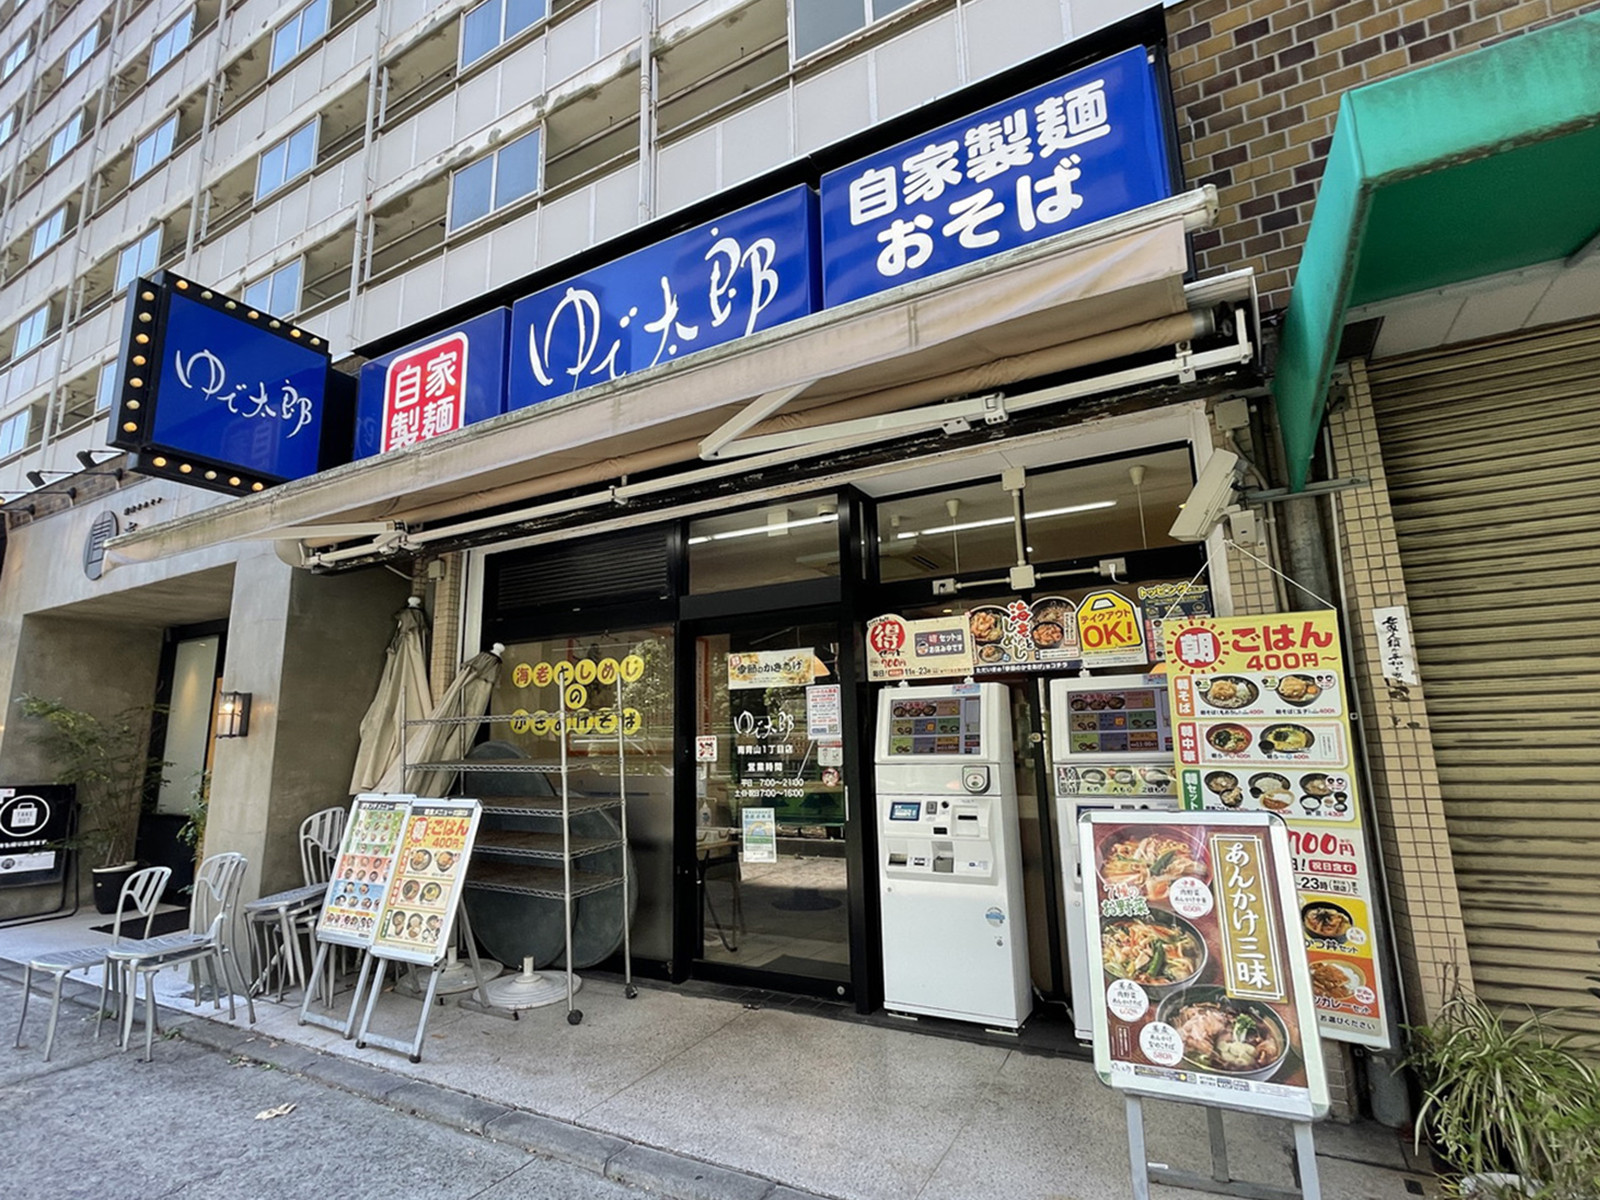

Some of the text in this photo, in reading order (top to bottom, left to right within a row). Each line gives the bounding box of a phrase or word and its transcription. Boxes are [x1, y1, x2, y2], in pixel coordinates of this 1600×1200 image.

[849, 79, 1111, 226] 自家製麺
[876, 153, 1083, 277] おそば
[174, 350, 313, 439] ゆで太郎
[394, 350, 456, 409] 自家
[875, 623, 900, 649] 得
[1081, 610, 1130, 625] テイクアウト
[1083, 622, 1132, 648] OK!
[1180, 622, 1333, 663] 朝 ごはん
[1103, 899, 1150, 917] お野菜
